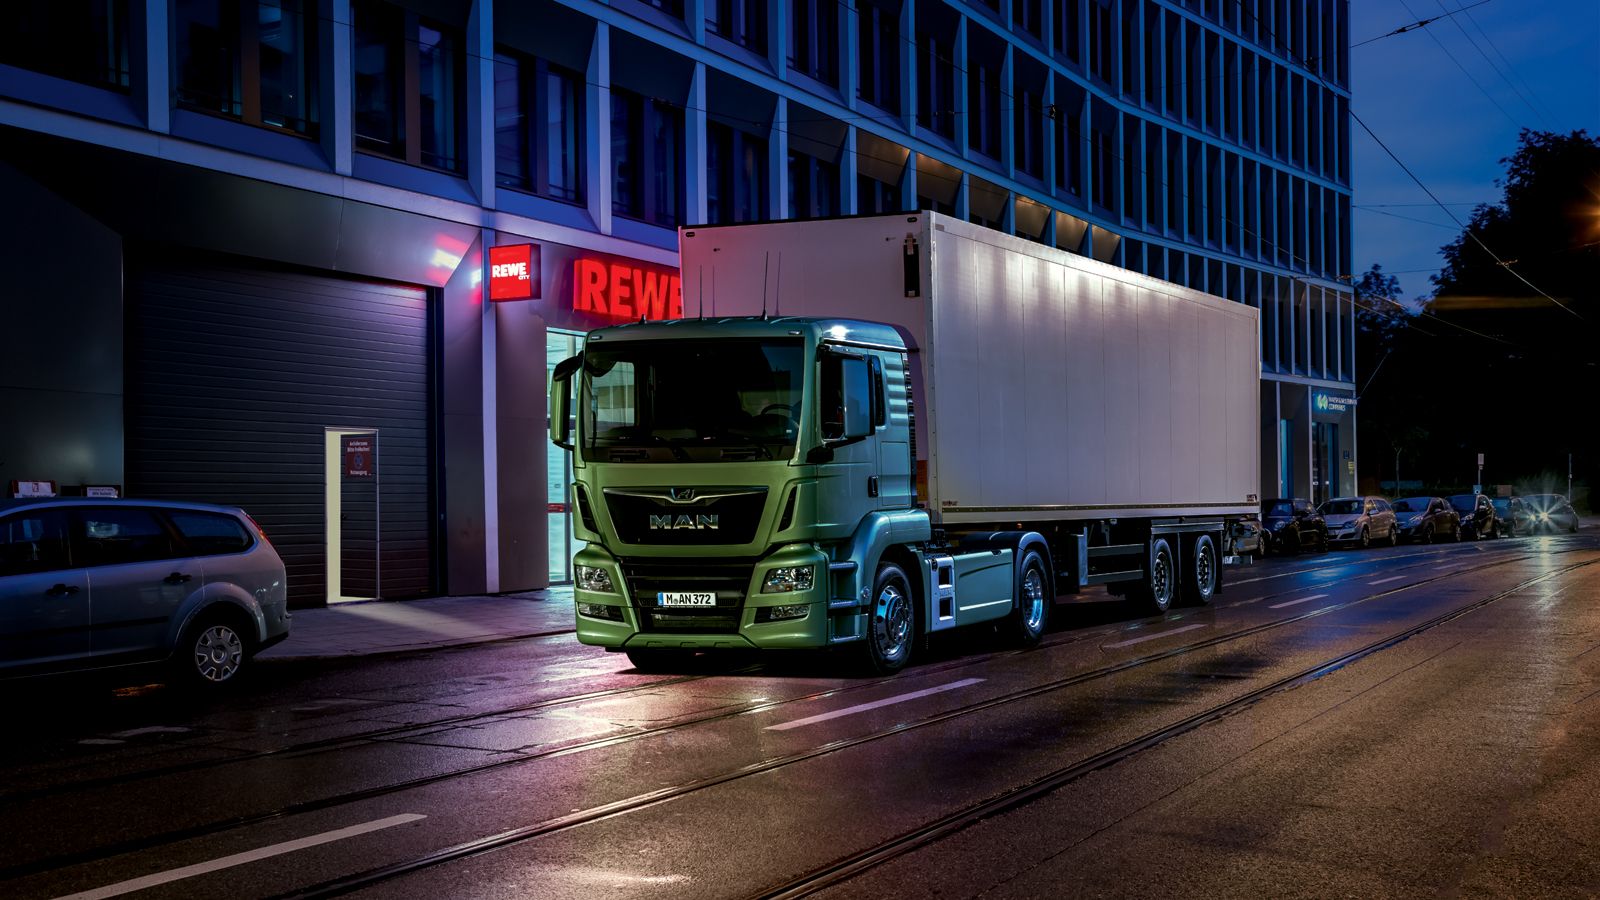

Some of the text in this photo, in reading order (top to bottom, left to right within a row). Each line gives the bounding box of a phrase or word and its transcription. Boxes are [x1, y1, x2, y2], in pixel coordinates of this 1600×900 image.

[492, 262, 527, 278] REWE
[649, 514, 719, 529] MAN
[666, 593, 673, 604] M
[693, 593, 711, 604] 372
